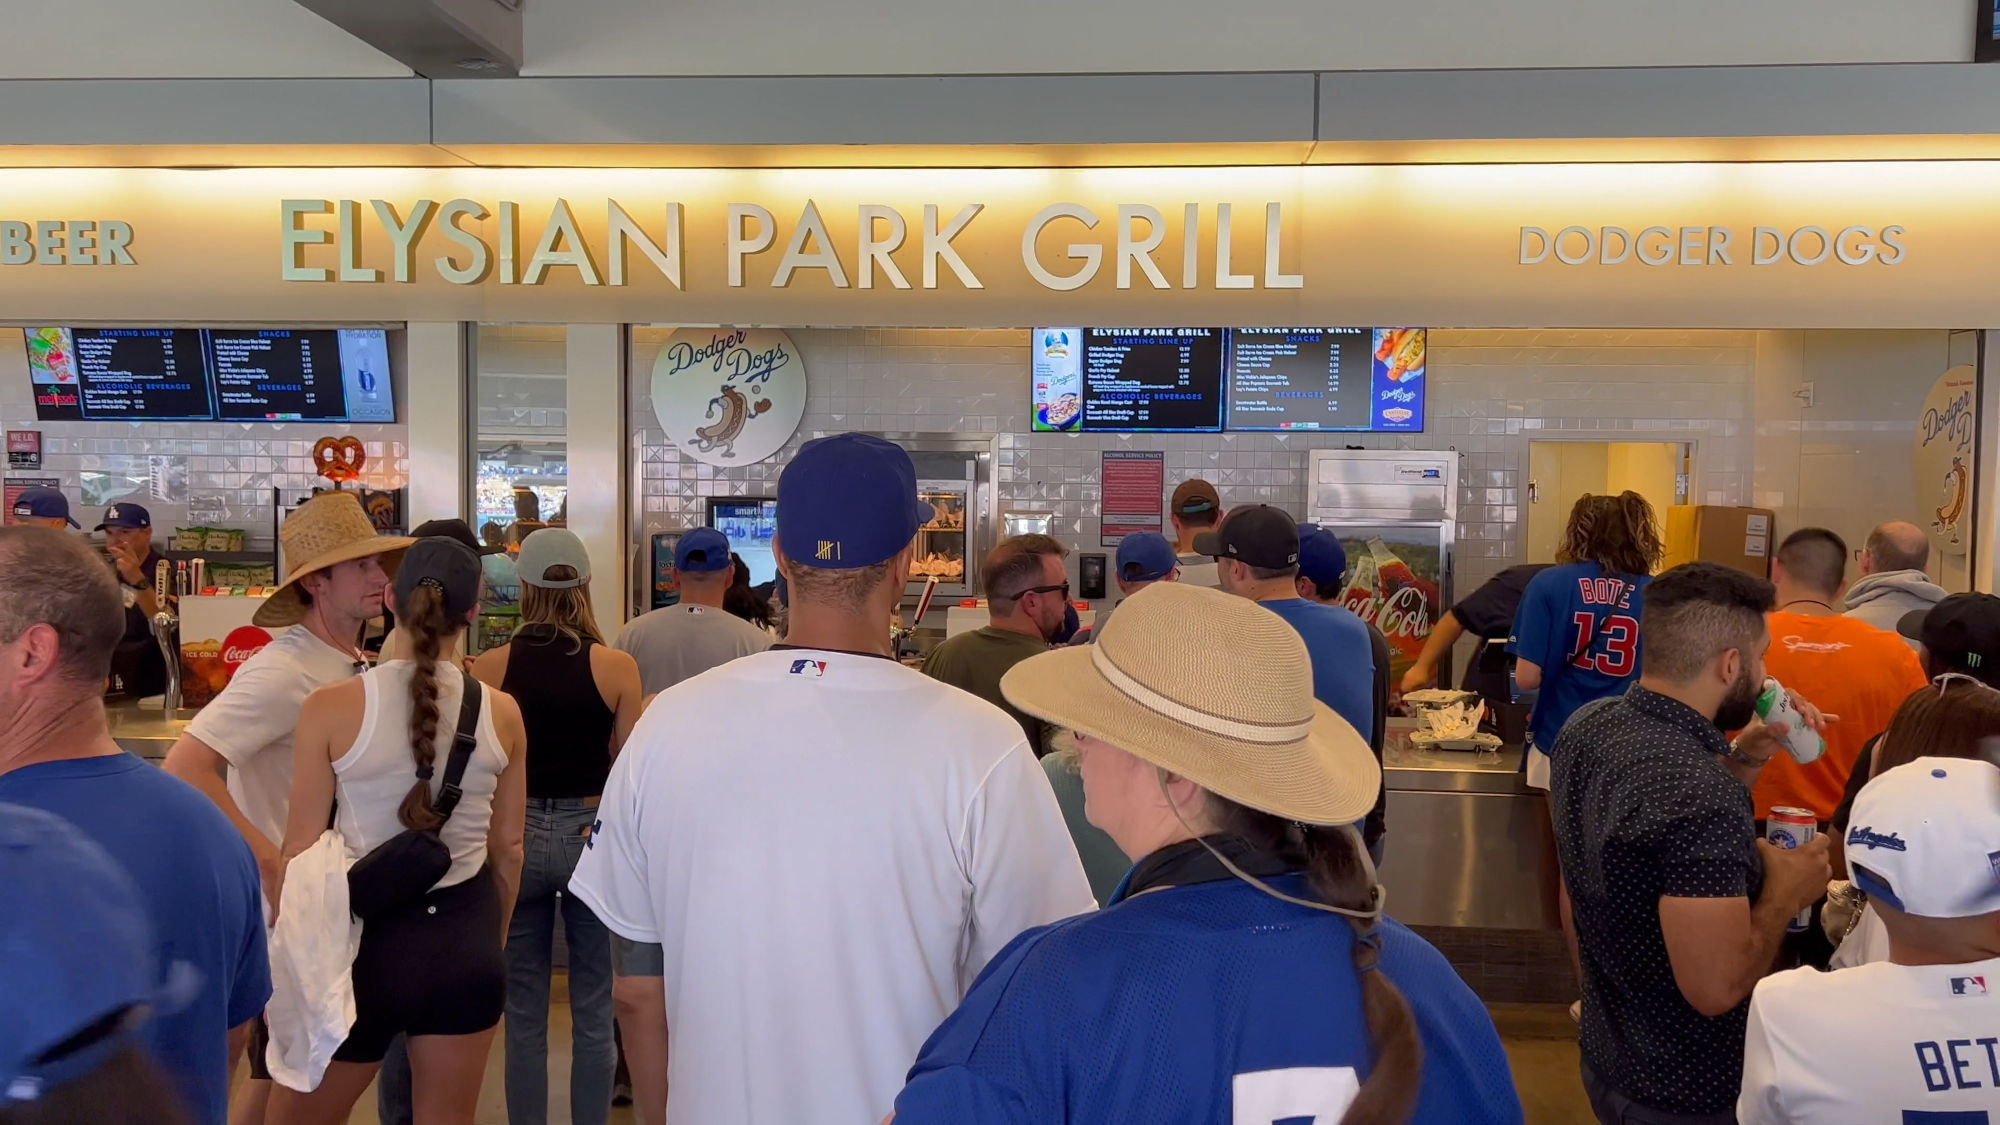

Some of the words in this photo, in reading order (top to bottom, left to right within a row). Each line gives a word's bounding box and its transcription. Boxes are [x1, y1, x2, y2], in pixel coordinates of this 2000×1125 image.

[0, 220, 138, 266] BEER
[281, 198, 686, 290] ELYSIAN
[727, 198, 986, 289] PARK
[1022, 202, 1304, 291] GRILL
[1518, 224, 1736, 266] DODGER
[1752, 224, 1906, 266] DOGS
[668, 330, 746, 375] Dodger
[726, 343, 789, 383] Dogs
[1923, 390, 1971, 447] Dodger
[1578, 578, 1636, 609] BOTE
[1390, 647, 1403, 655] gic
[1567, 611, 1639, 677] 13
[1914, 1038, 2000, 1092] BET
